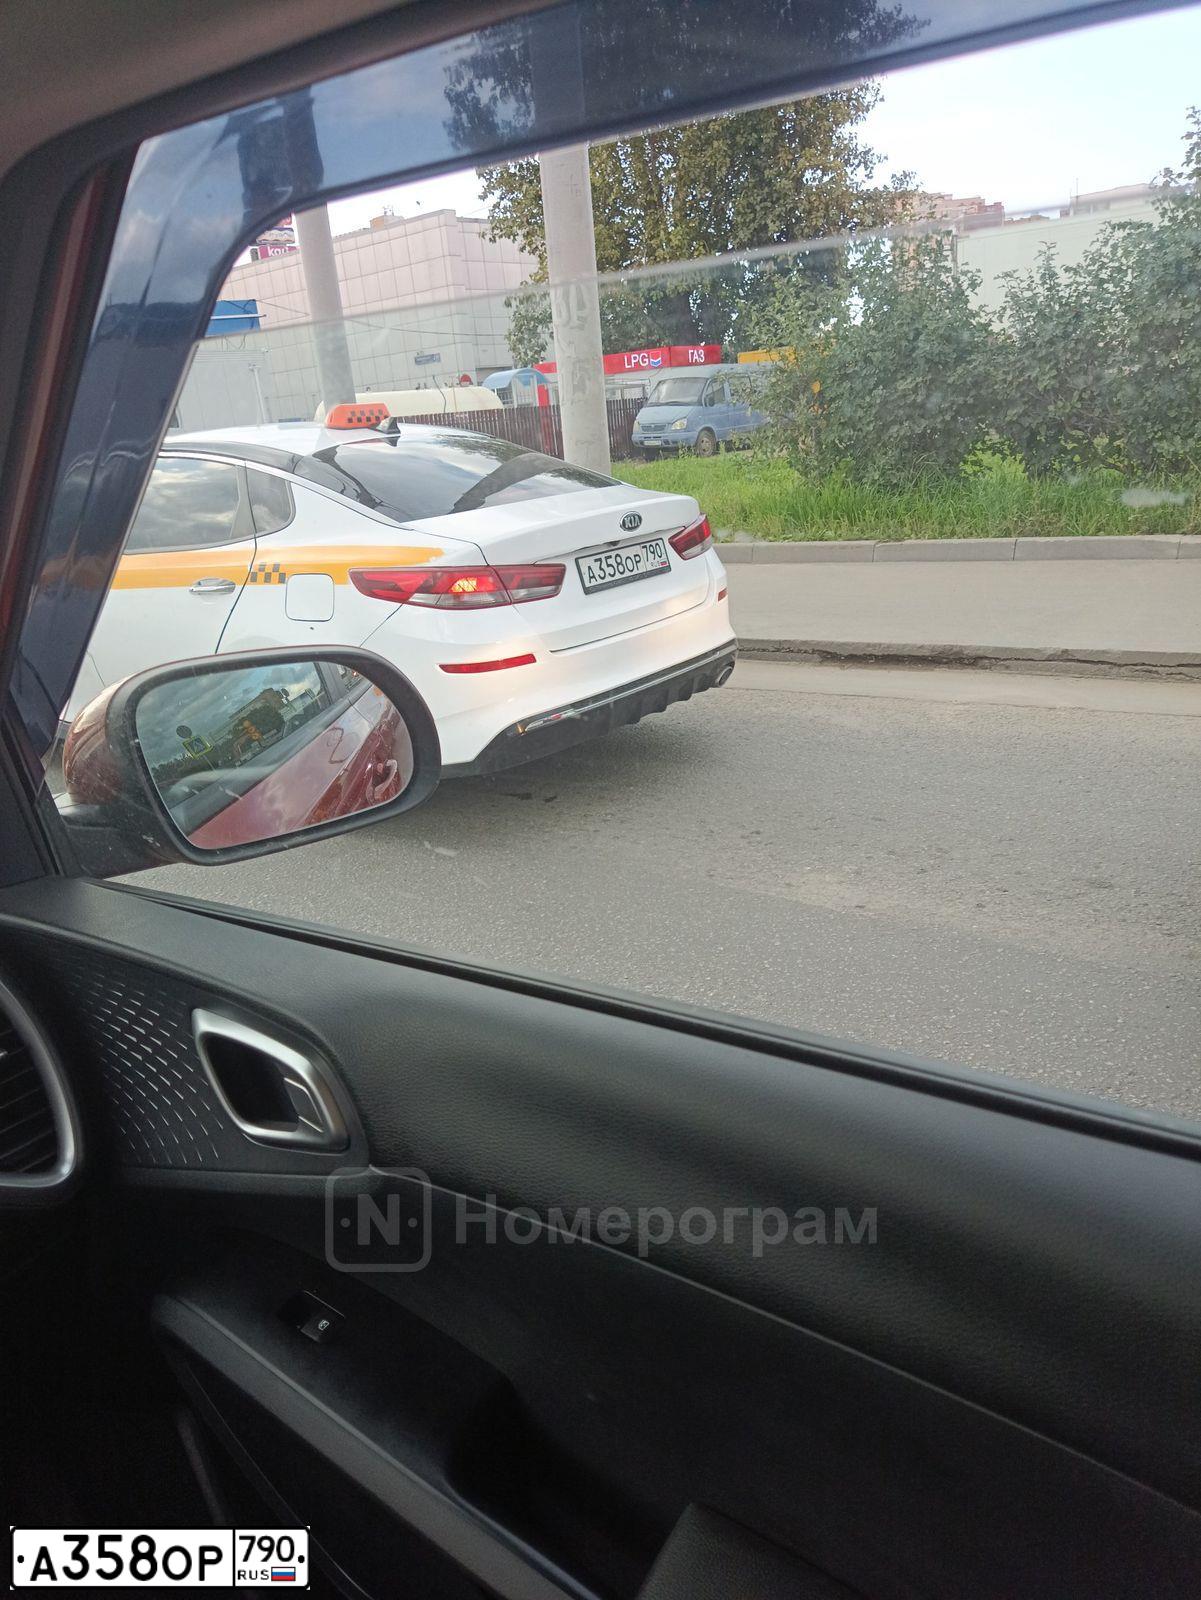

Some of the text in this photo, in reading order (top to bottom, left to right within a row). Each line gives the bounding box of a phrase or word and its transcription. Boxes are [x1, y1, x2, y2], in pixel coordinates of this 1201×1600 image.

[624, 353, 649, 369] LPG
[688, 349, 705, 363] ГАЗ
[624, 514, 641, 529] KIA
[641, 543, 663, 562] 790
